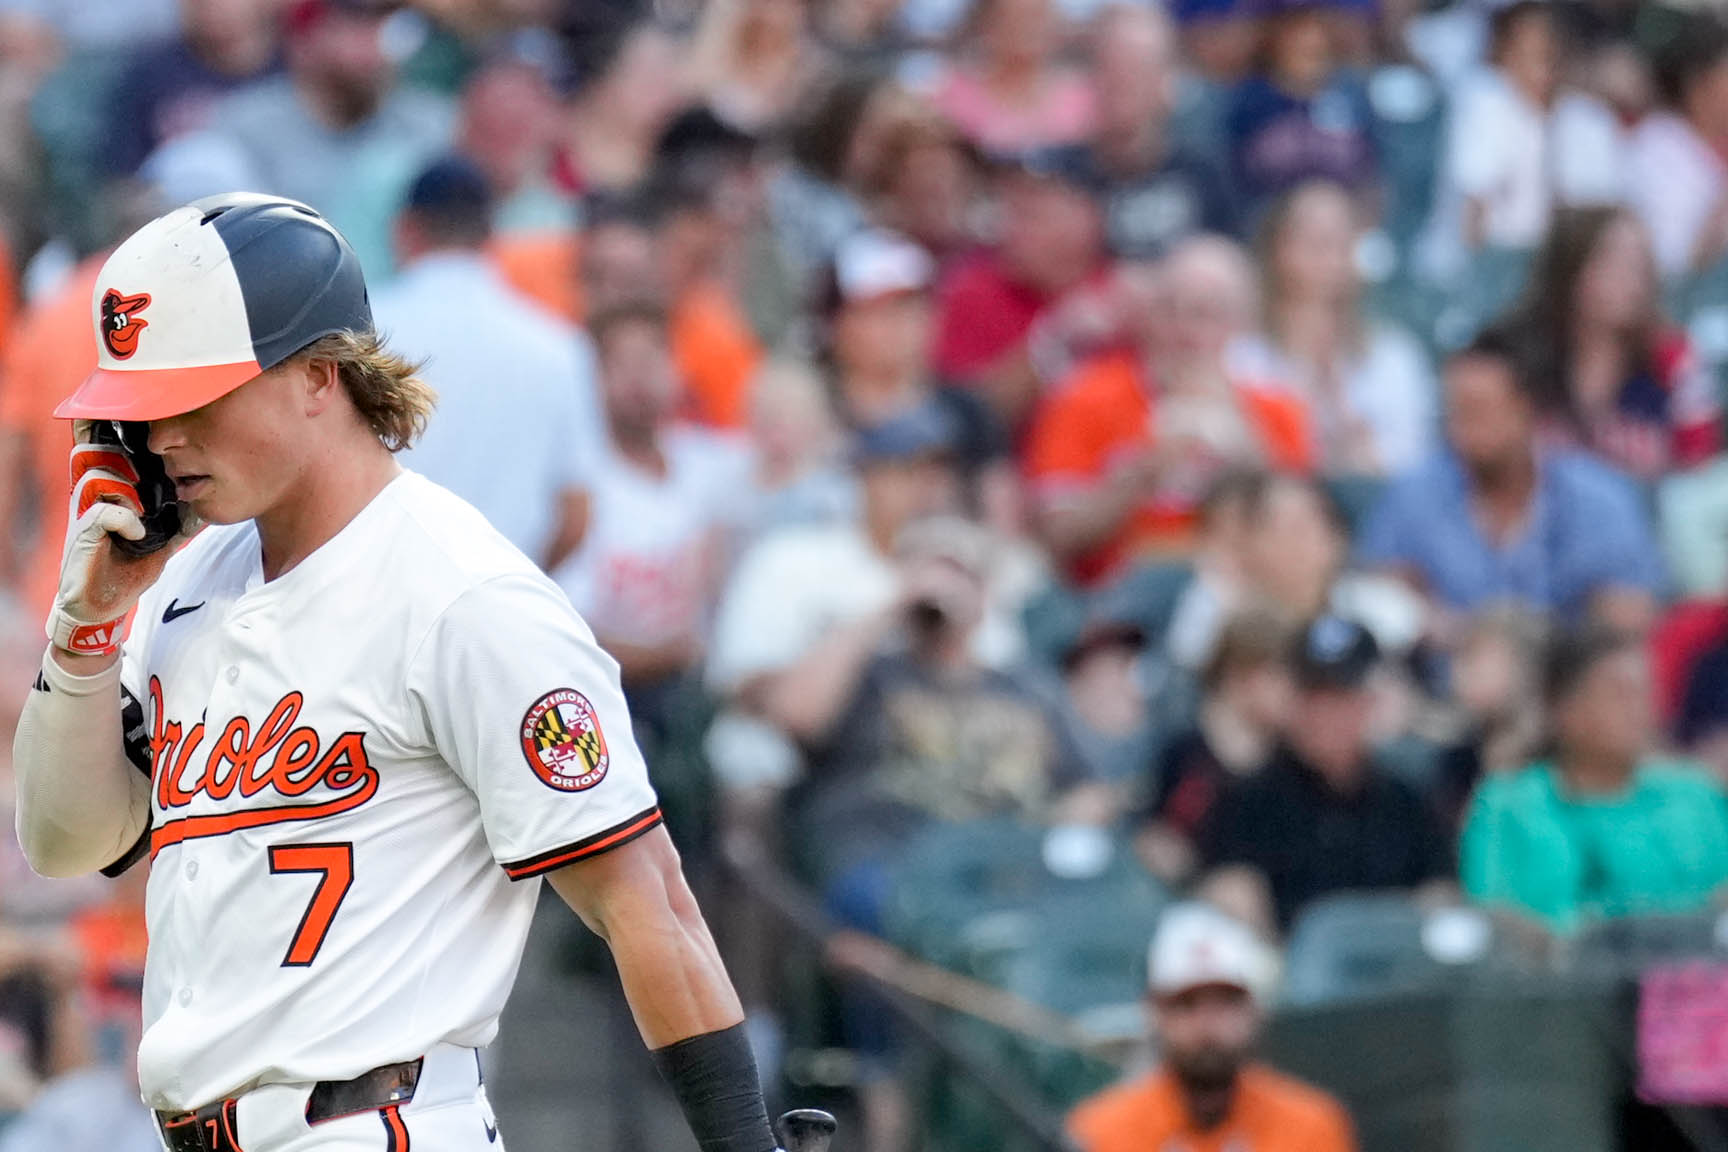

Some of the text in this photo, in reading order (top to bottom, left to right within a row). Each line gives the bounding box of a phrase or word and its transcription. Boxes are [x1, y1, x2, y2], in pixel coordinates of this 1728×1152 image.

[149, 674, 379, 813] rioles
[267, 841, 355, 968] 7
[206, 1119, 219, 1150] 7
